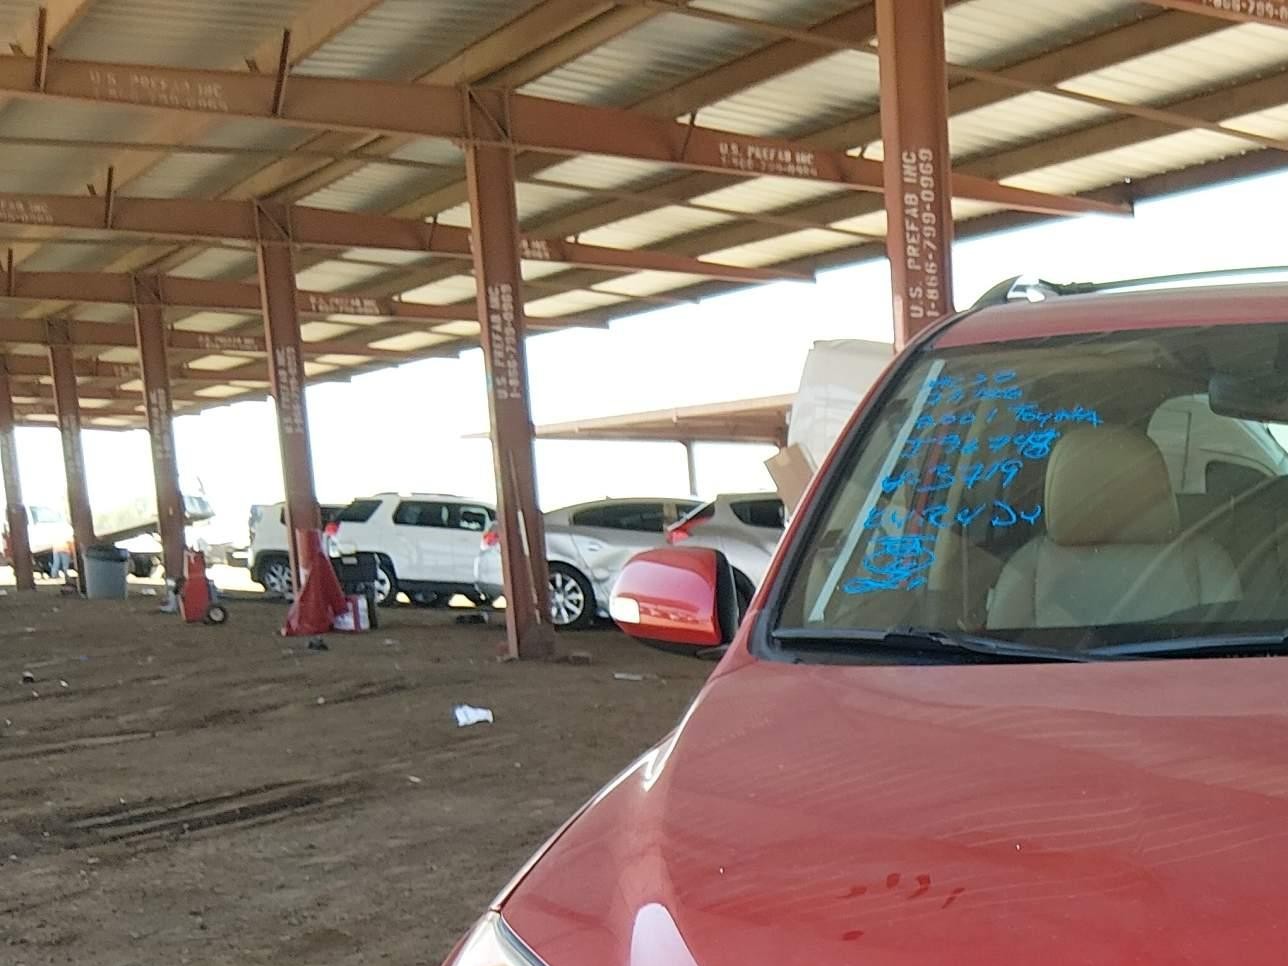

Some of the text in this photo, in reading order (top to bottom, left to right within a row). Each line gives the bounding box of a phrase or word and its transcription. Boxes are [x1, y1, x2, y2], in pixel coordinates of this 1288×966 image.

[902, 151, 918, 184] INC
[904, 191, 921, 270] PREFAB
[918, 148, 940, 318] 1-866-799-0969
